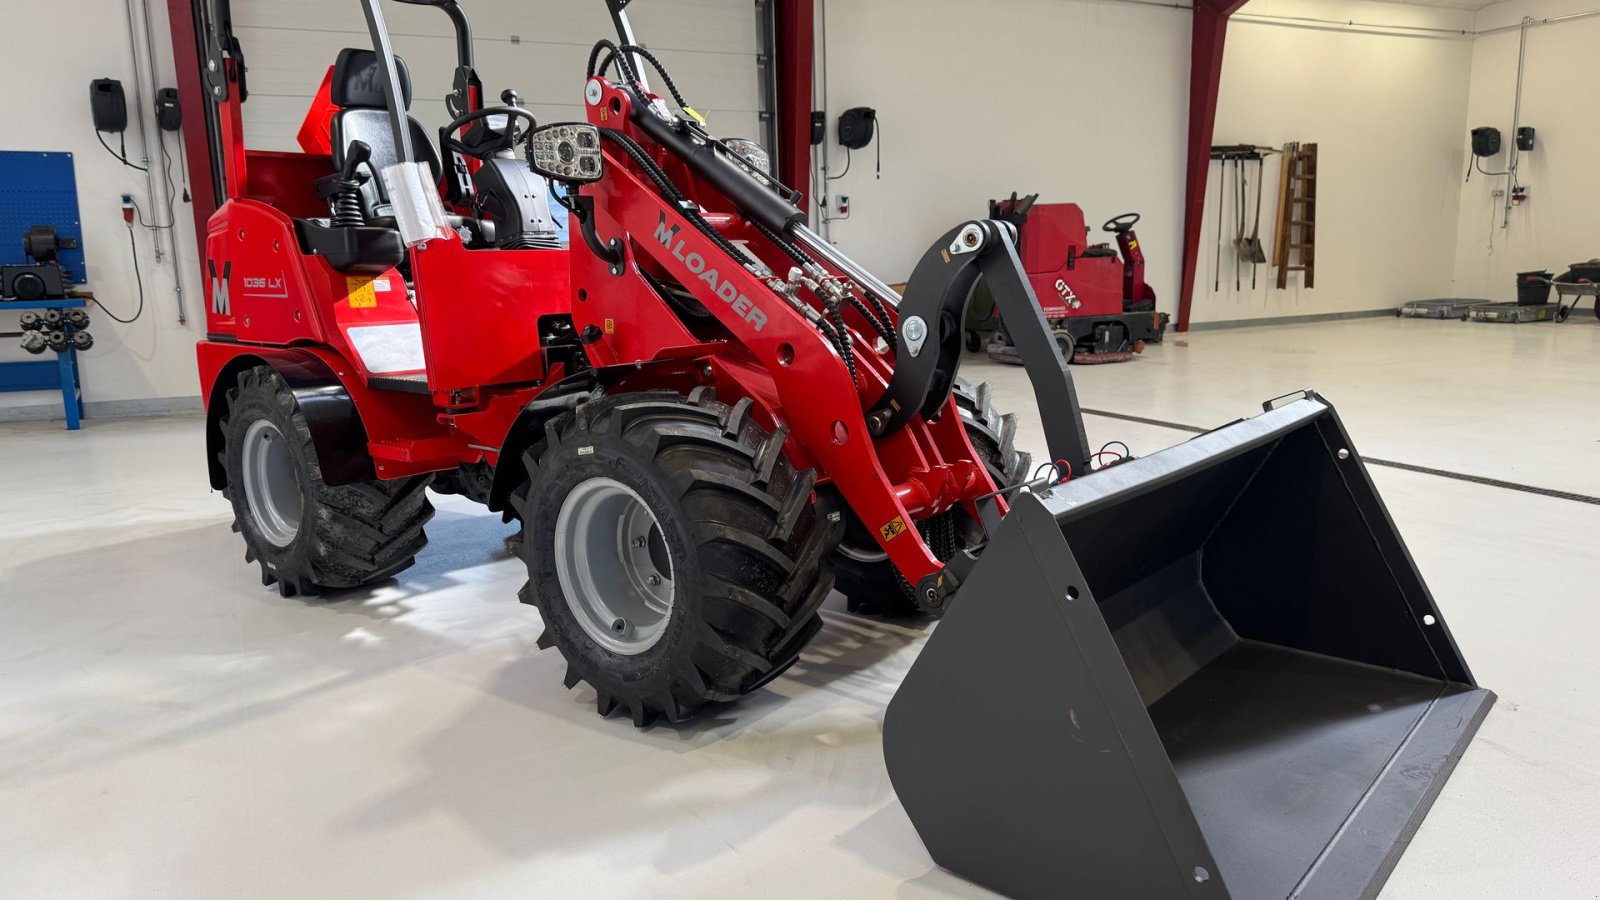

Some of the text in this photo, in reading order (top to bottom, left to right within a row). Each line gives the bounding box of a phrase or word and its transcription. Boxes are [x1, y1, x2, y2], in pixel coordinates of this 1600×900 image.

[243, 277, 282, 288] 1036 LX
[1055, 279, 1076, 304] GTX
